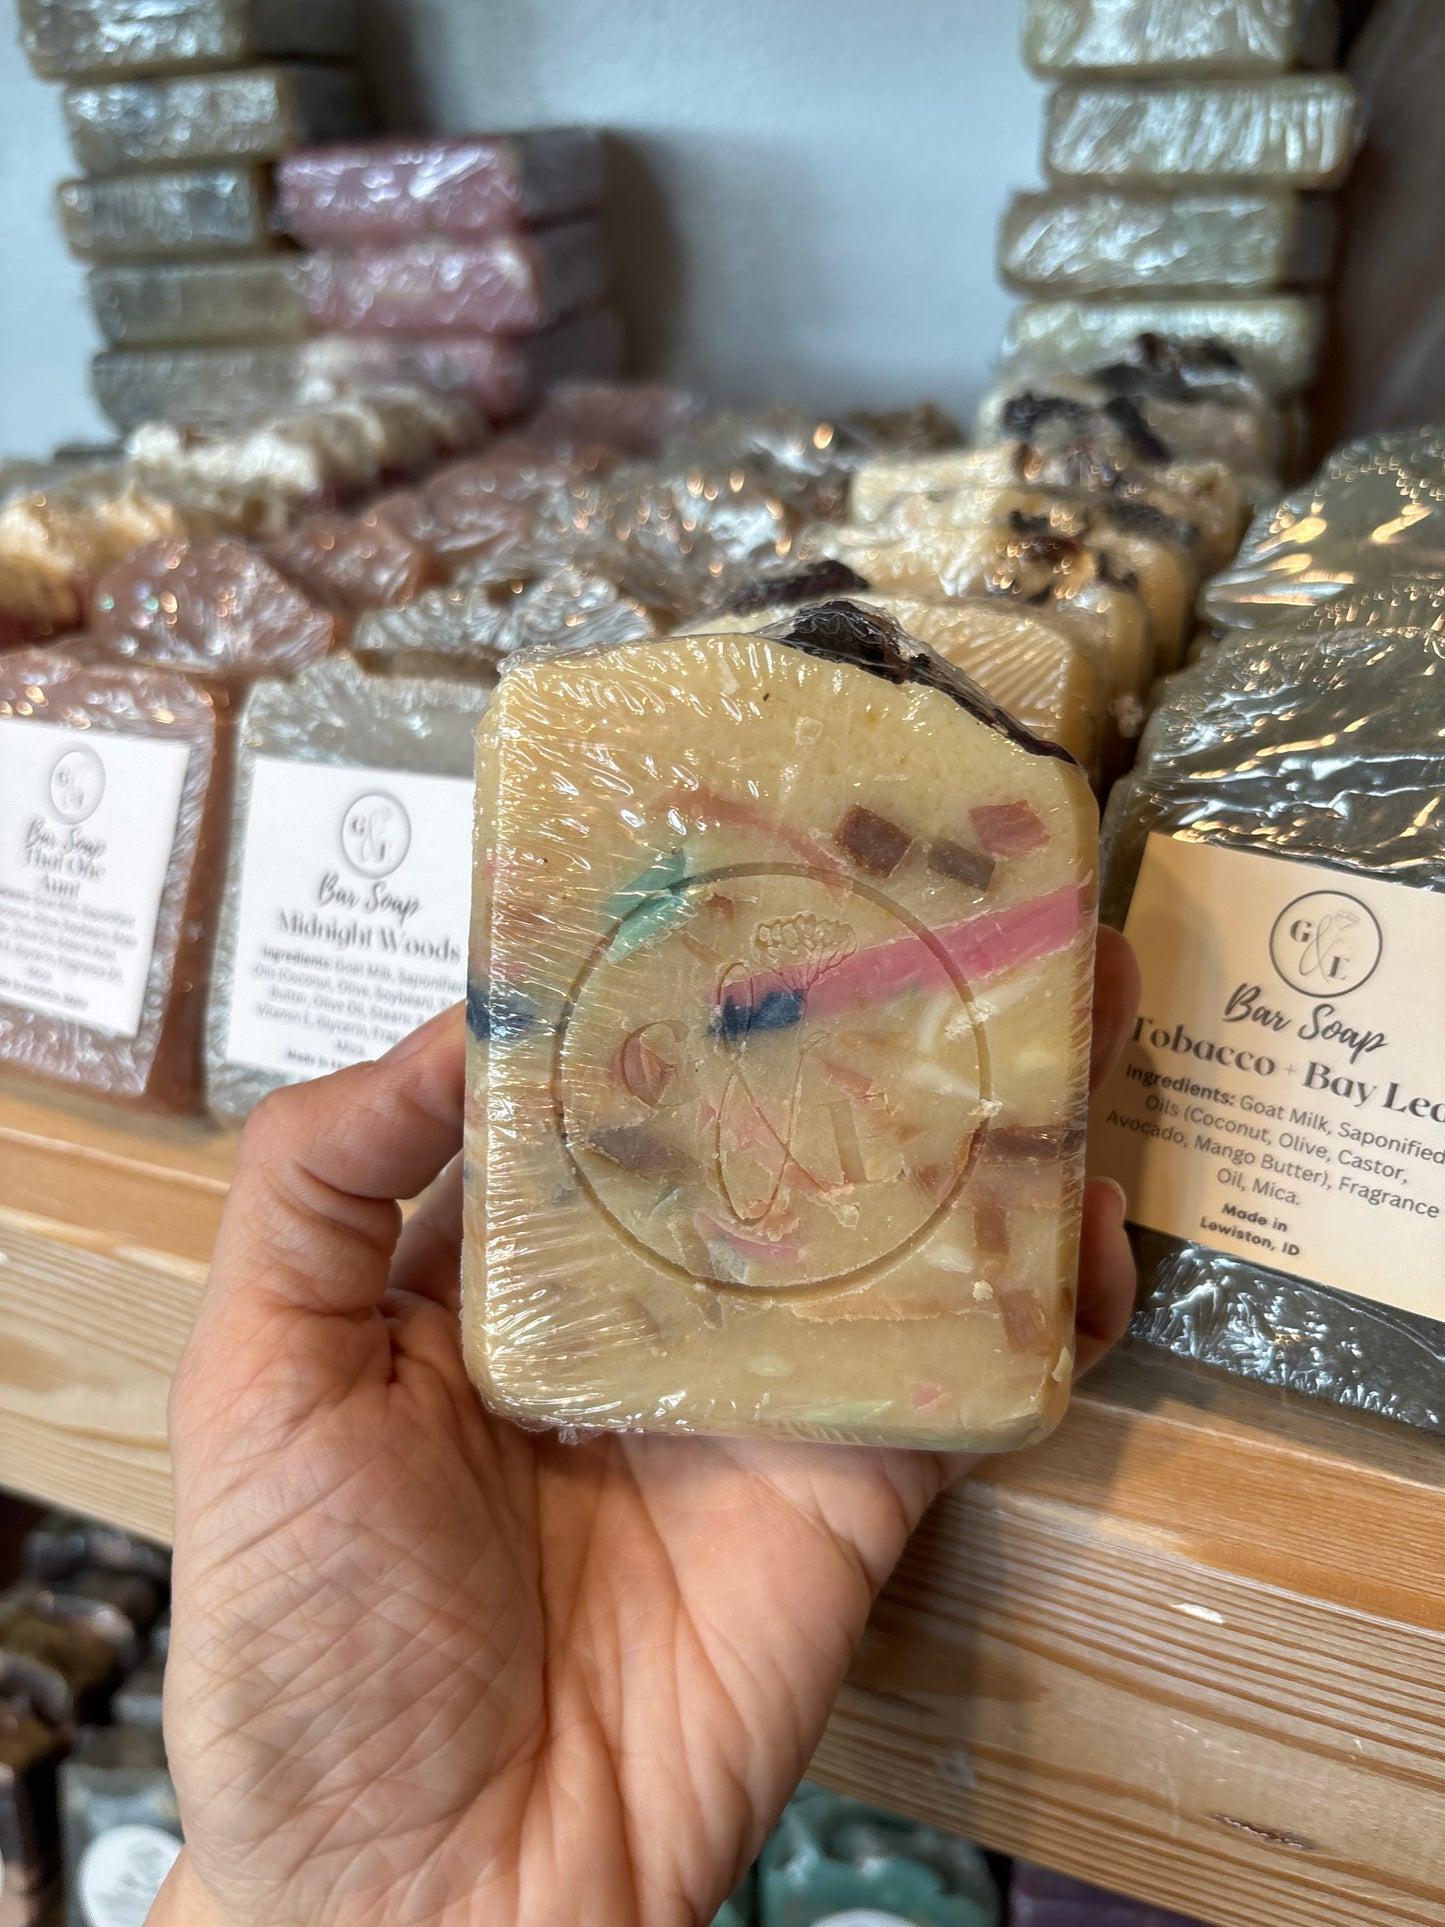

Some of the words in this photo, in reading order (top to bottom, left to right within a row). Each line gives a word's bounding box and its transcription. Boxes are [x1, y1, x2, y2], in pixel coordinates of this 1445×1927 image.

[315, 871, 361, 907] Bar
[364, 880, 420, 926] Soap
[278, 908, 372, 951] Midnight
[378, 925, 461, 963] Woods
[1221, 982, 1291, 1032] Bar
[1297, 1003, 1389, 1065] Soap
[1131, 1016, 1276, 1077] Tobacco
[1302, 1060, 1378, 1108] Bay
[1126, 1063, 1236, 1107] Ingredients:
[1239, 1094, 1286, 1121] Goat
[1289, 1108, 1332, 1136] Milk,
[1338, 1121, 1445, 1165] Saponified
[1144, 1094, 1179, 1117] Oils
[1183, 1104, 1273, 1146] (Coconut,
[1278, 1132, 1332, 1163] Olive,
[1338, 1149, 1408, 1185] Castor,
[1105, 1110, 1188, 1148] Avocado,
[1194, 1135, 1256, 1165] Mango
[1260, 1154, 1332, 1191] Butter),
[1338, 1176, 1440, 1218] Fragrance
[1217, 1168, 1246, 1192] Oil,
[1252, 1178, 1301, 1206] Mica.
[1200, 1216, 1276, 1251] Lewiston,
[1281, 1241, 1301, 1256] ID
[1221, 1203, 1268, 1226] Made
[1272, 1217, 1288, 1233] in
